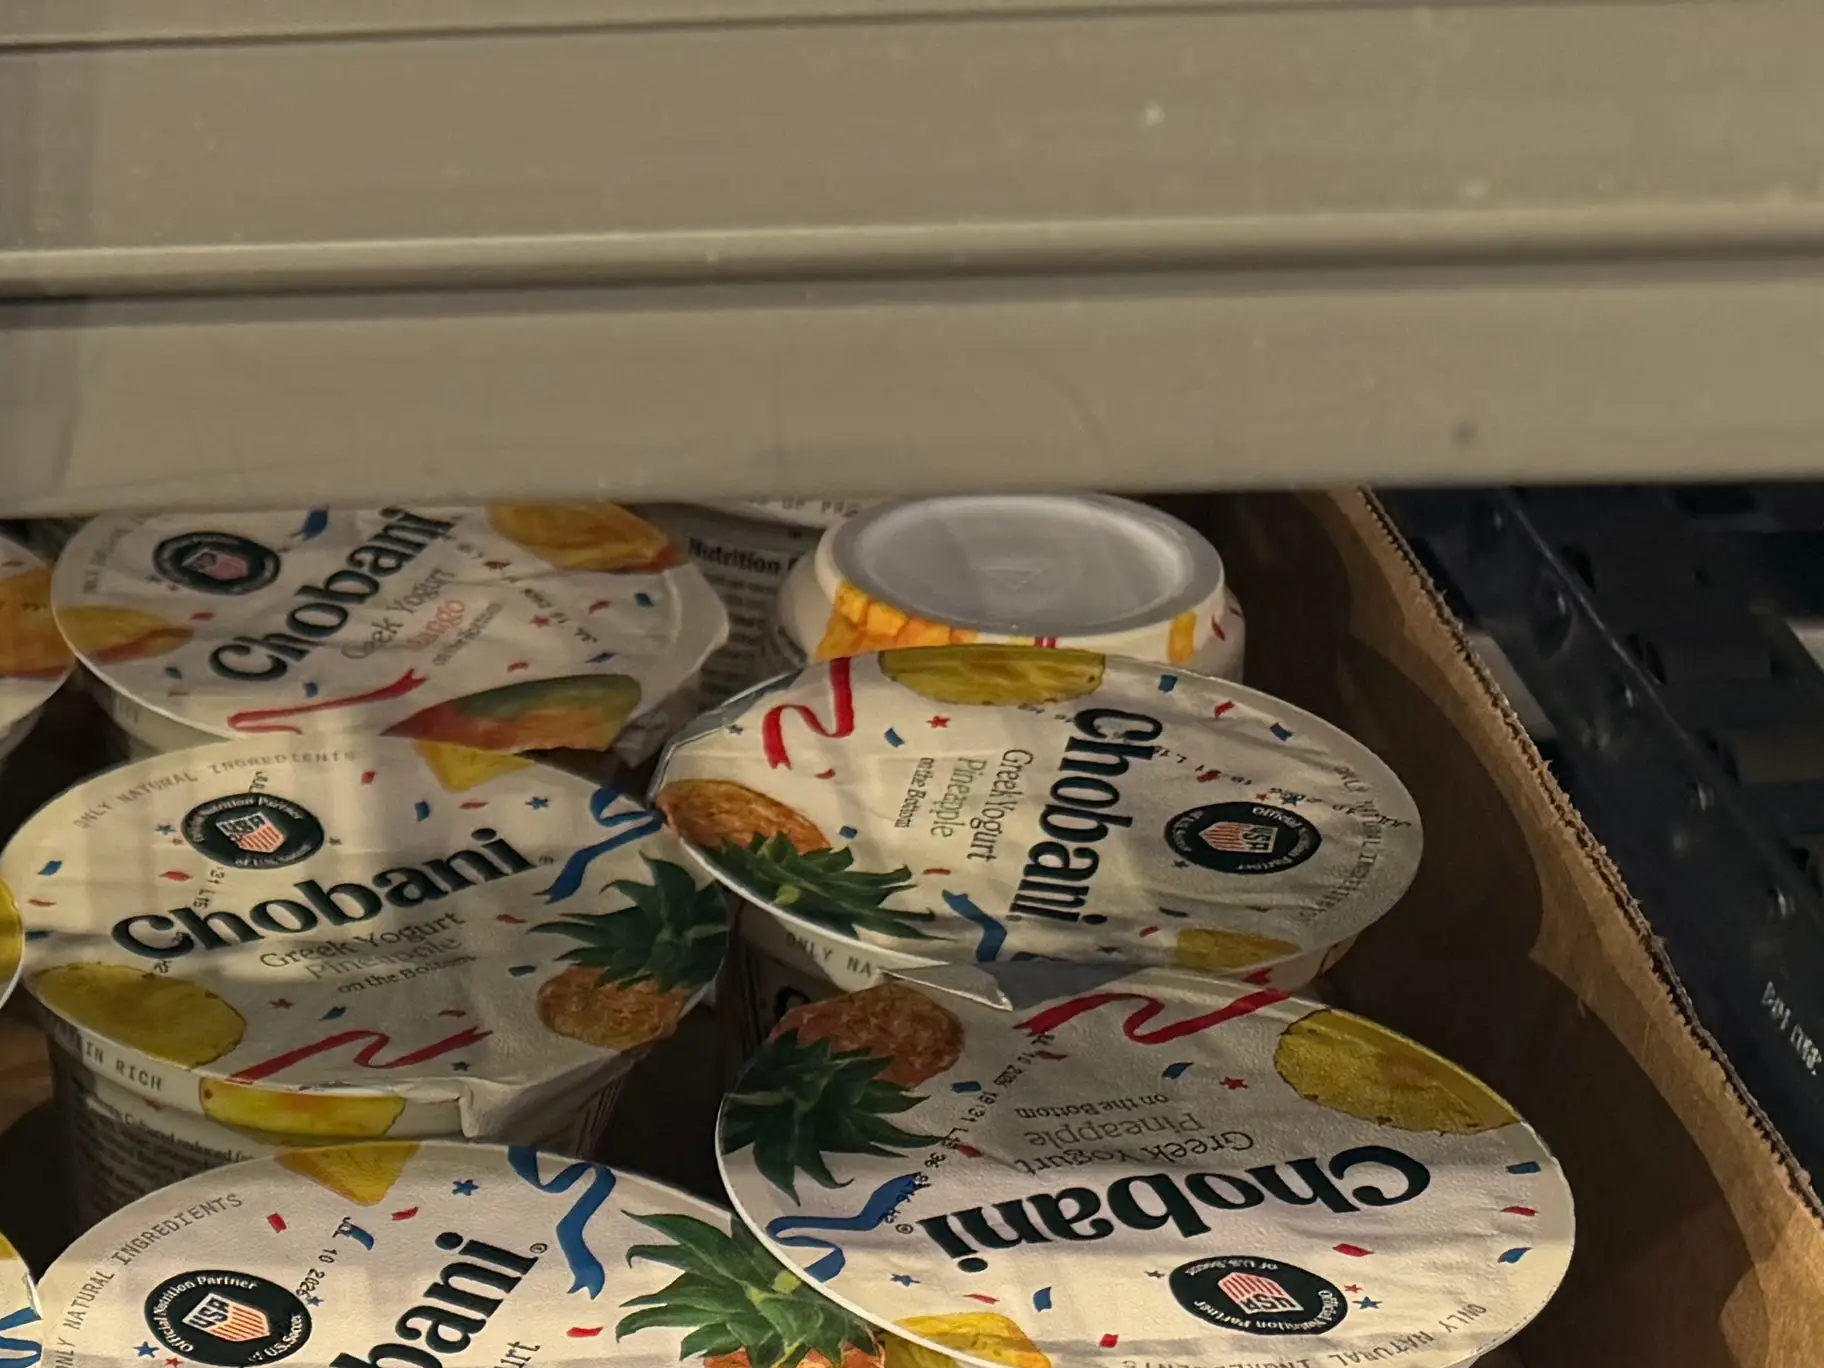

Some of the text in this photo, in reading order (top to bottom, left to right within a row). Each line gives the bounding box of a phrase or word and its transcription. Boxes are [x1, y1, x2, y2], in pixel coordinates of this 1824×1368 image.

[930, 757, 988, 838] Pineapple
[965, 749, 1034, 862] Greek Yogurt
[1009, 709, 1164, 925] Chobani
[111, 827, 538, 961] Chobani
[259, 911, 465, 971] Greek Yogurt
[115, 1056, 163, 1092] RICH
[1014, 1099, 1096, 1121] Bottom
[1023, 1111, 1203, 1150] Pineapple
[1014, 1127, 1254, 1177] Greek Yogurt
[915, 1144, 1432, 1274] Chobani
[63, 1270, 114, 1331] NATURAL
[111, 1194, 243, 1265] INGREDIENTS
[317, 1247, 337, 1265] 10
[154, 1315, 194, 1353] Official
[196, 1276, 258, 1291] Partner
[188, 1296, 231, 1330] USA
[1441, 1304, 1488, 1335] ONLY
[1328, 1323, 1439, 1368] NATURAL
